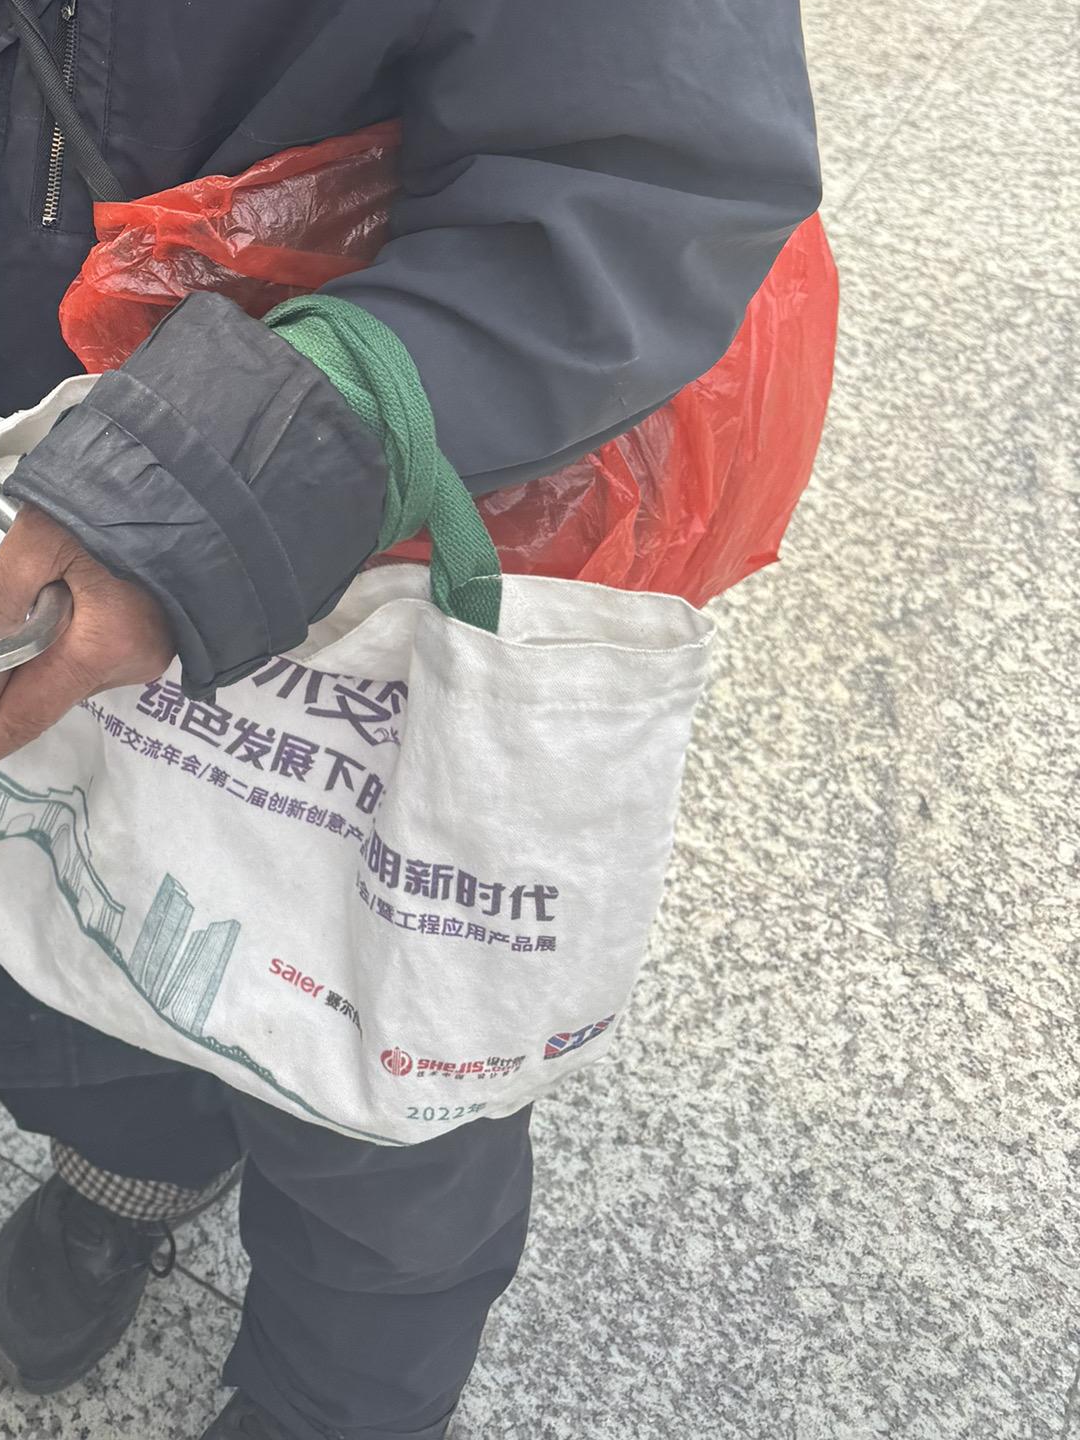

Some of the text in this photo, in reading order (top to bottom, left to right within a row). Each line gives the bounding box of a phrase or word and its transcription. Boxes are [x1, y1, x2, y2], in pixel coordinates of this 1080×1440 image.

[80, 699, 370, 861] 计师交流年会/第二届创新创意产
[406, 1102, 487, 1121] 2022年
